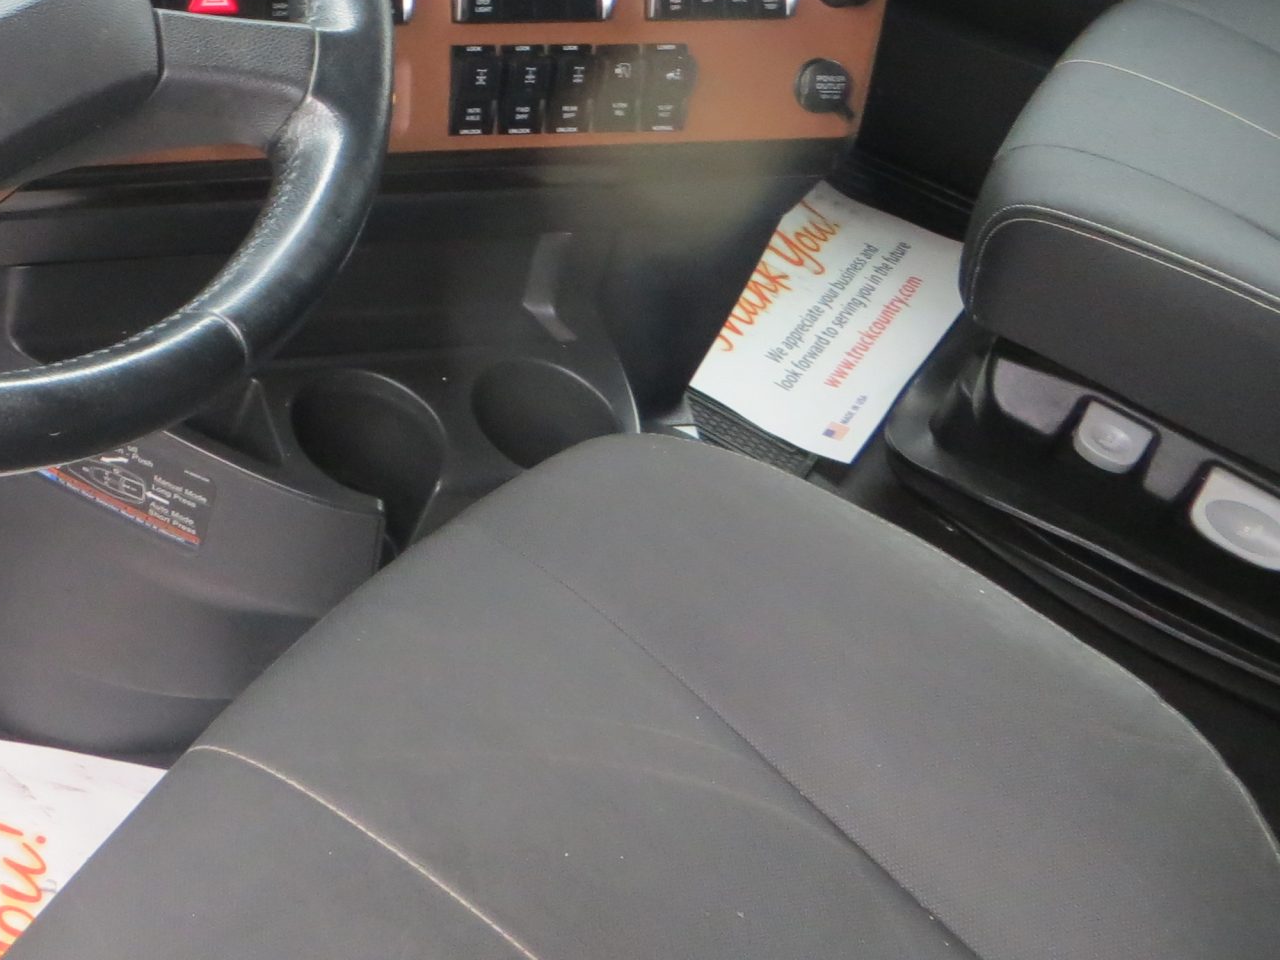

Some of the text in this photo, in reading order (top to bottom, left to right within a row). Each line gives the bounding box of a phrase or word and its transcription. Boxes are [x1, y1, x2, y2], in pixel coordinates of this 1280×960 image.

[881, 241, 912, 267] future
[872, 262, 894, 277] the
[764, 242, 880, 364] We appreciate your business and
[858, 283, 876, 302] you
[831, 297, 868, 329] serving
[821, 326, 839, 341] to
[823, 275, 924, 389] www.truckcountry.com
[791, 334, 831, 372] forward
[774, 369, 803, 391] look
